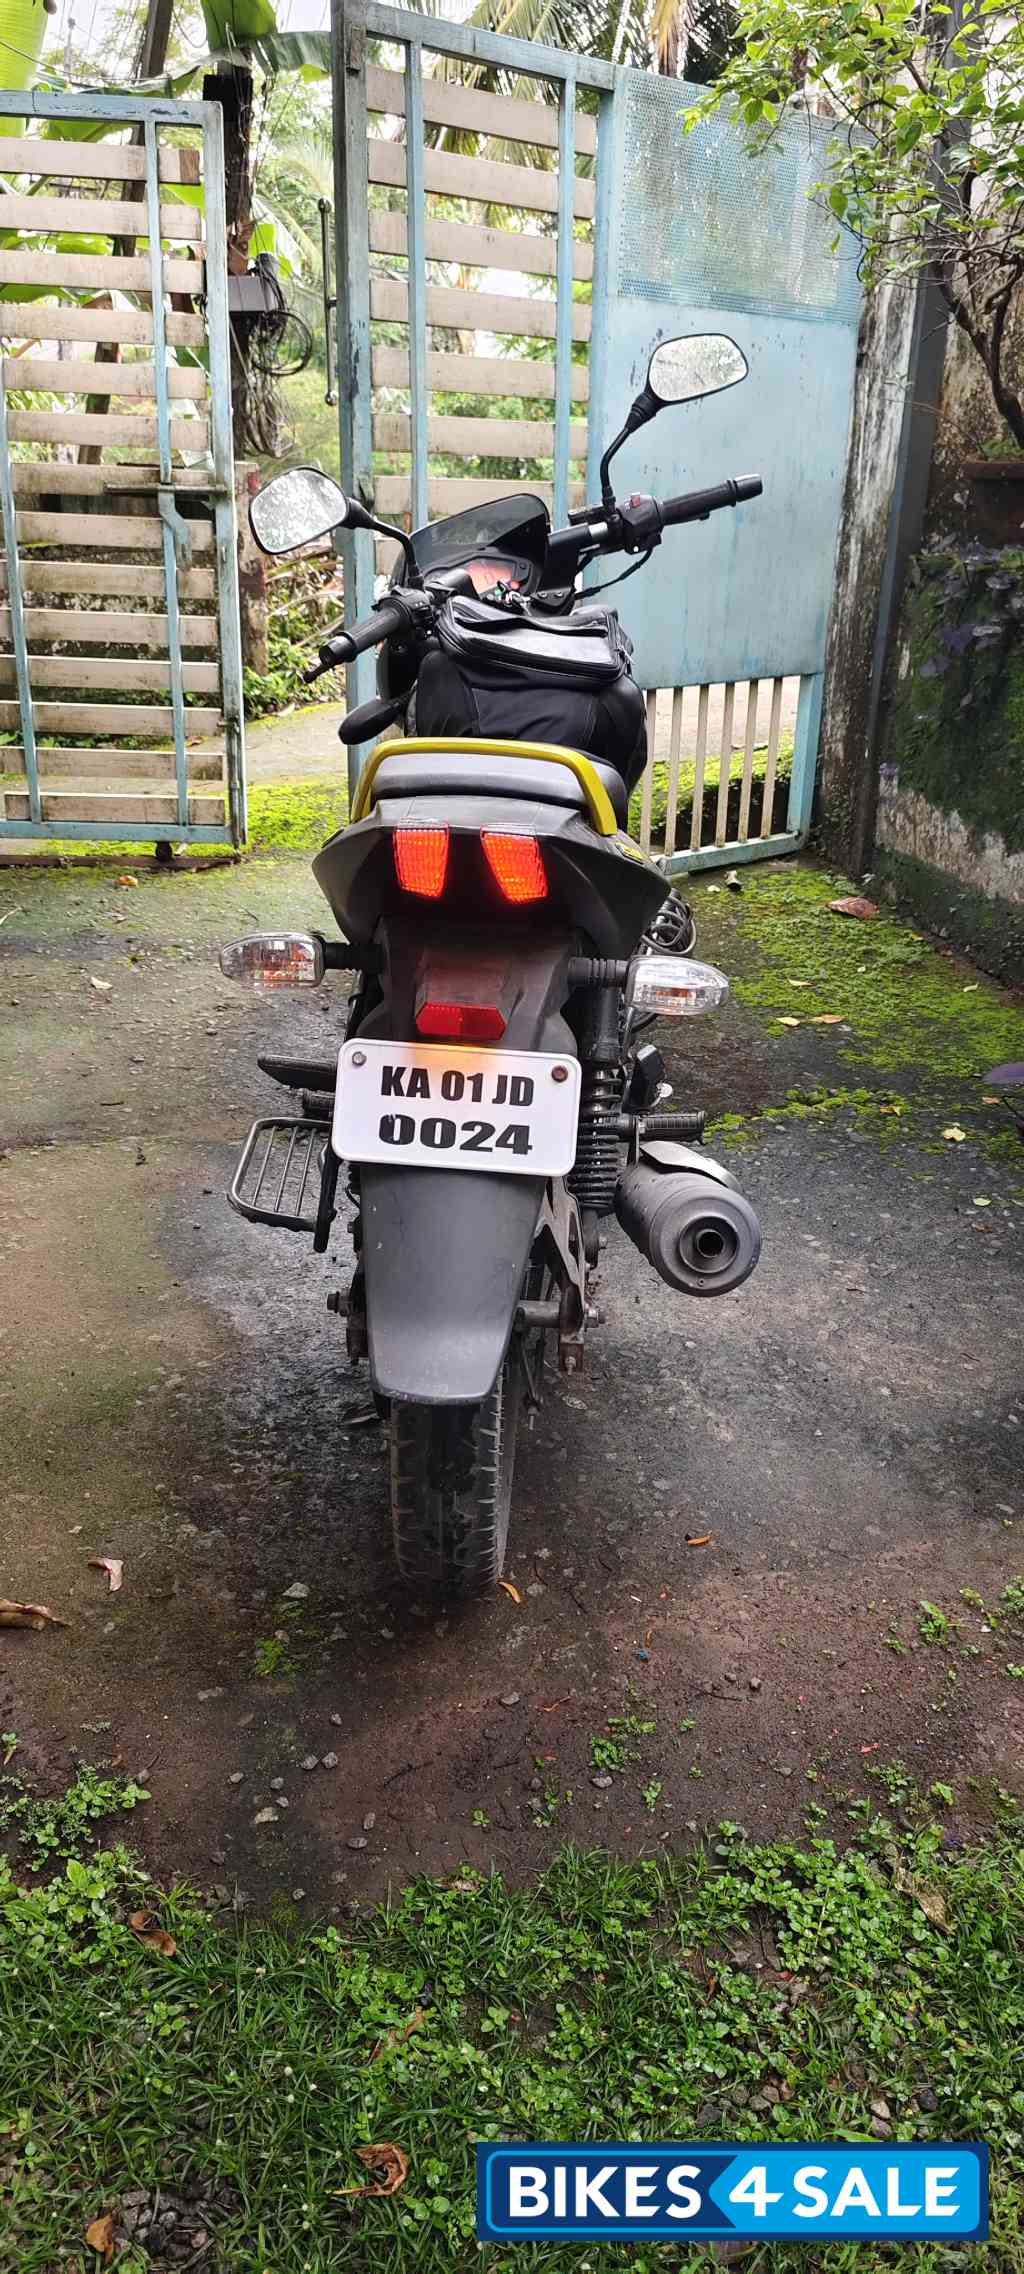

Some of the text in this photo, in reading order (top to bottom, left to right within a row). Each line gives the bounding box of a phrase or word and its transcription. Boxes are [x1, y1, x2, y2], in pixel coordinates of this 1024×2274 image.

[380, 1065, 534, 1107] KA 01 JD
[379, 1114, 533, 1155] 0024
